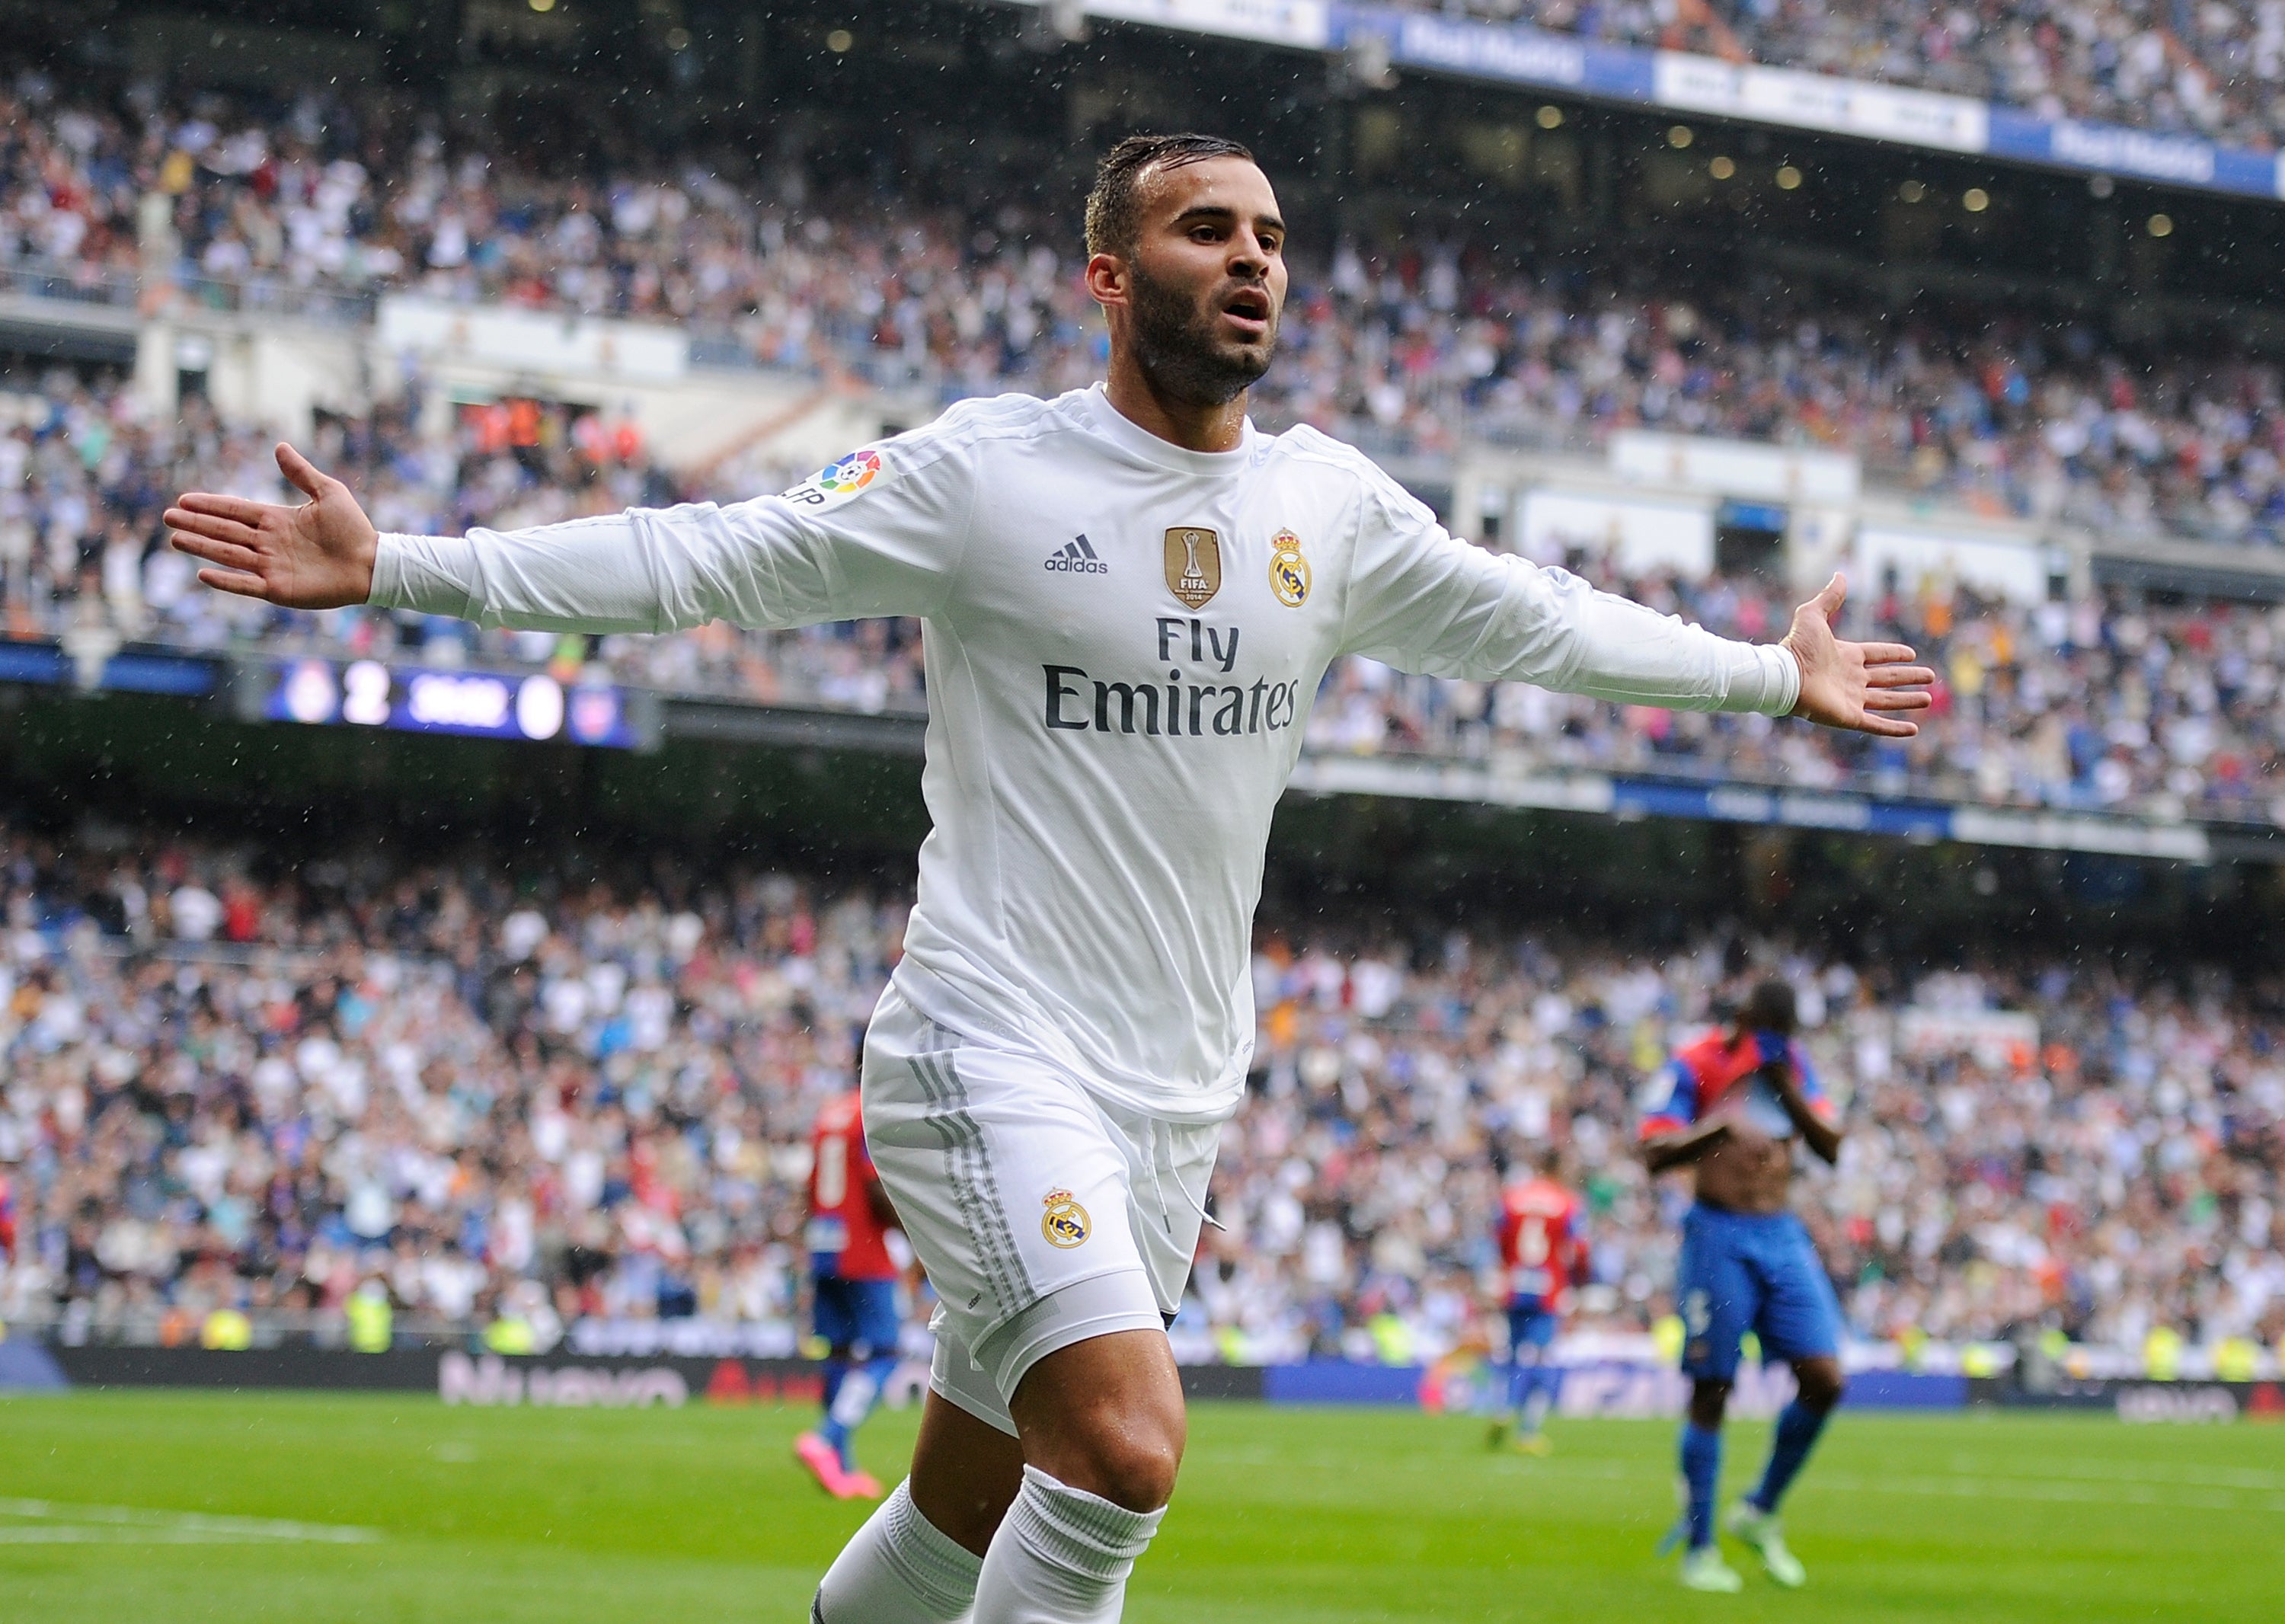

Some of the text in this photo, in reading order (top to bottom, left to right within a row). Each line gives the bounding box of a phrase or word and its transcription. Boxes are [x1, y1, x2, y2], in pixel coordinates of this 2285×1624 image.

[1043, 557, 1108, 574] adidas
[1180, 578, 1207, 590] FIFA
[1155, 617, 1240, 673] Fly
[1041, 663, 1299, 737] Emirates
